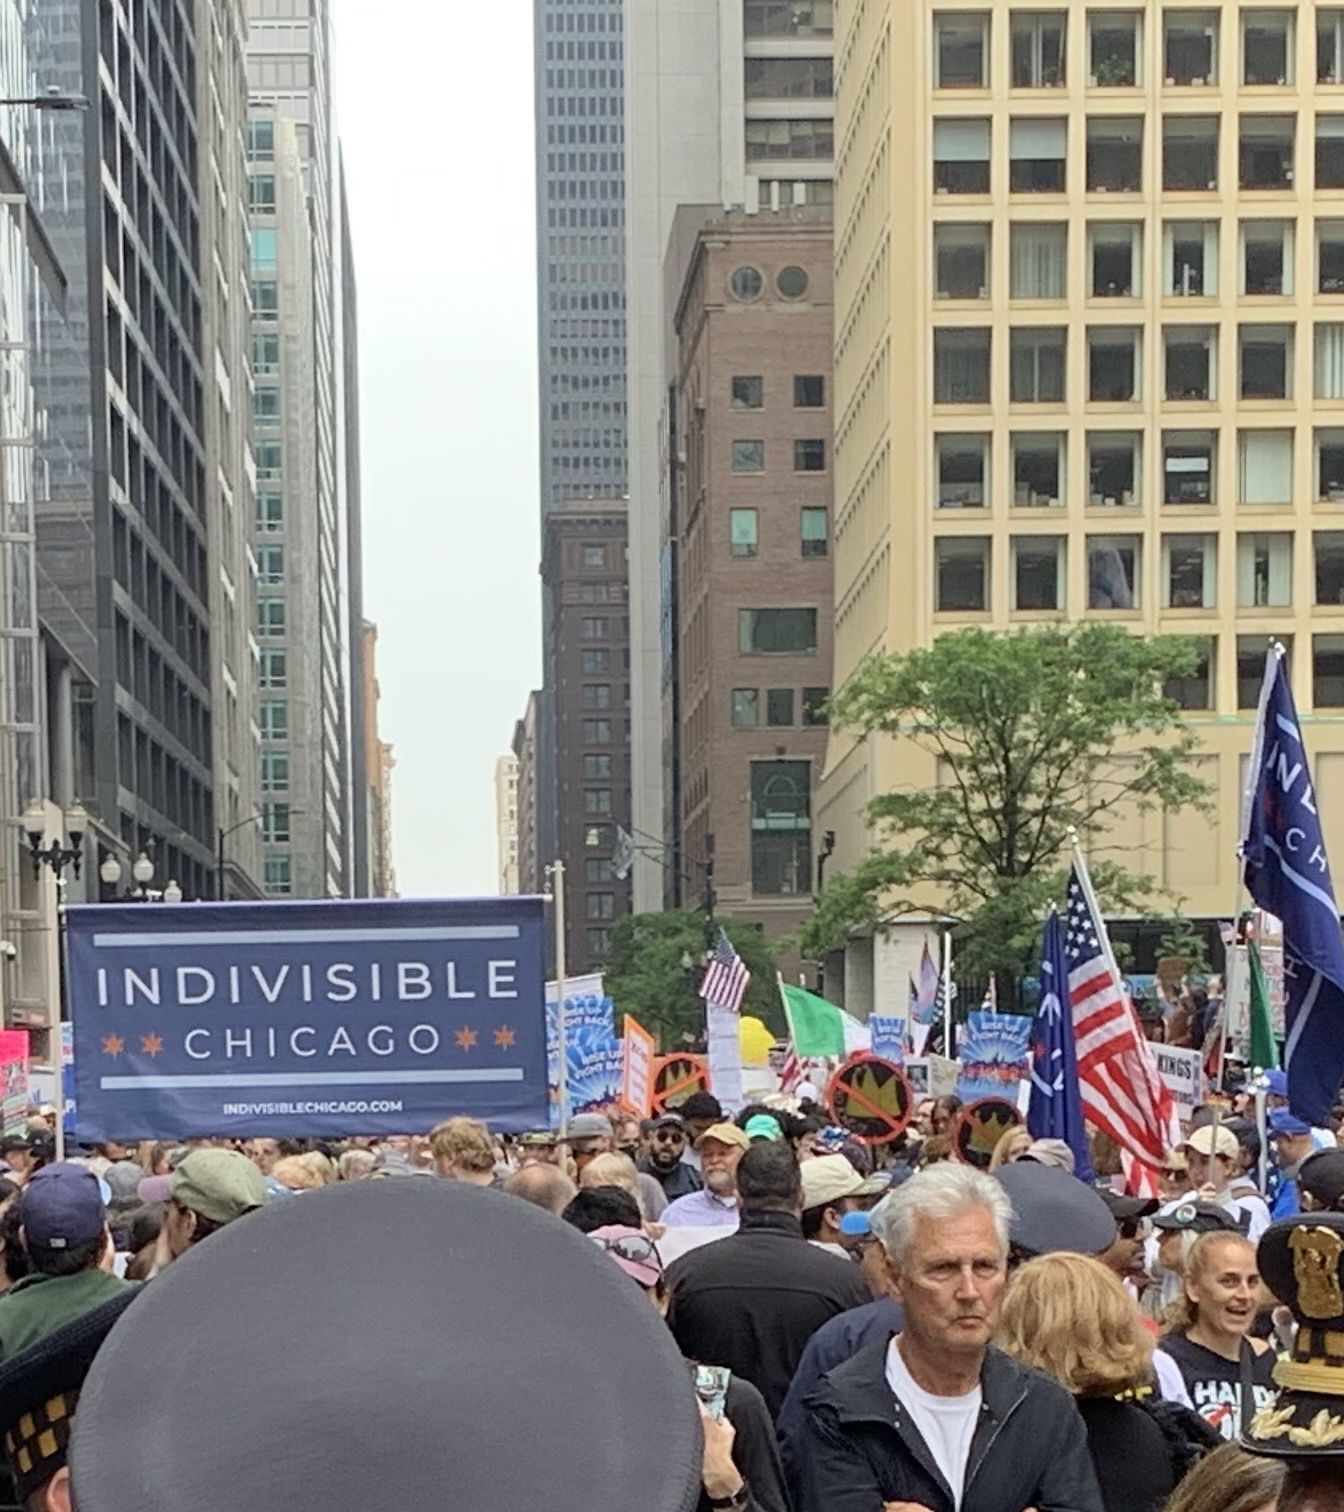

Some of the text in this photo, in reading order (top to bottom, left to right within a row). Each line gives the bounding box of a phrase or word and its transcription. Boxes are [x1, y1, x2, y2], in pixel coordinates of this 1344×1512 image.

[97, 960, 519, 1007] INDIVISIBLE
[183, 1023, 441, 1060] CHICAGO
[1157, 1053, 1192, 1080] KINGS
[222, 1099, 404, 1116] INDIVISIBLECHICAGO.COM
